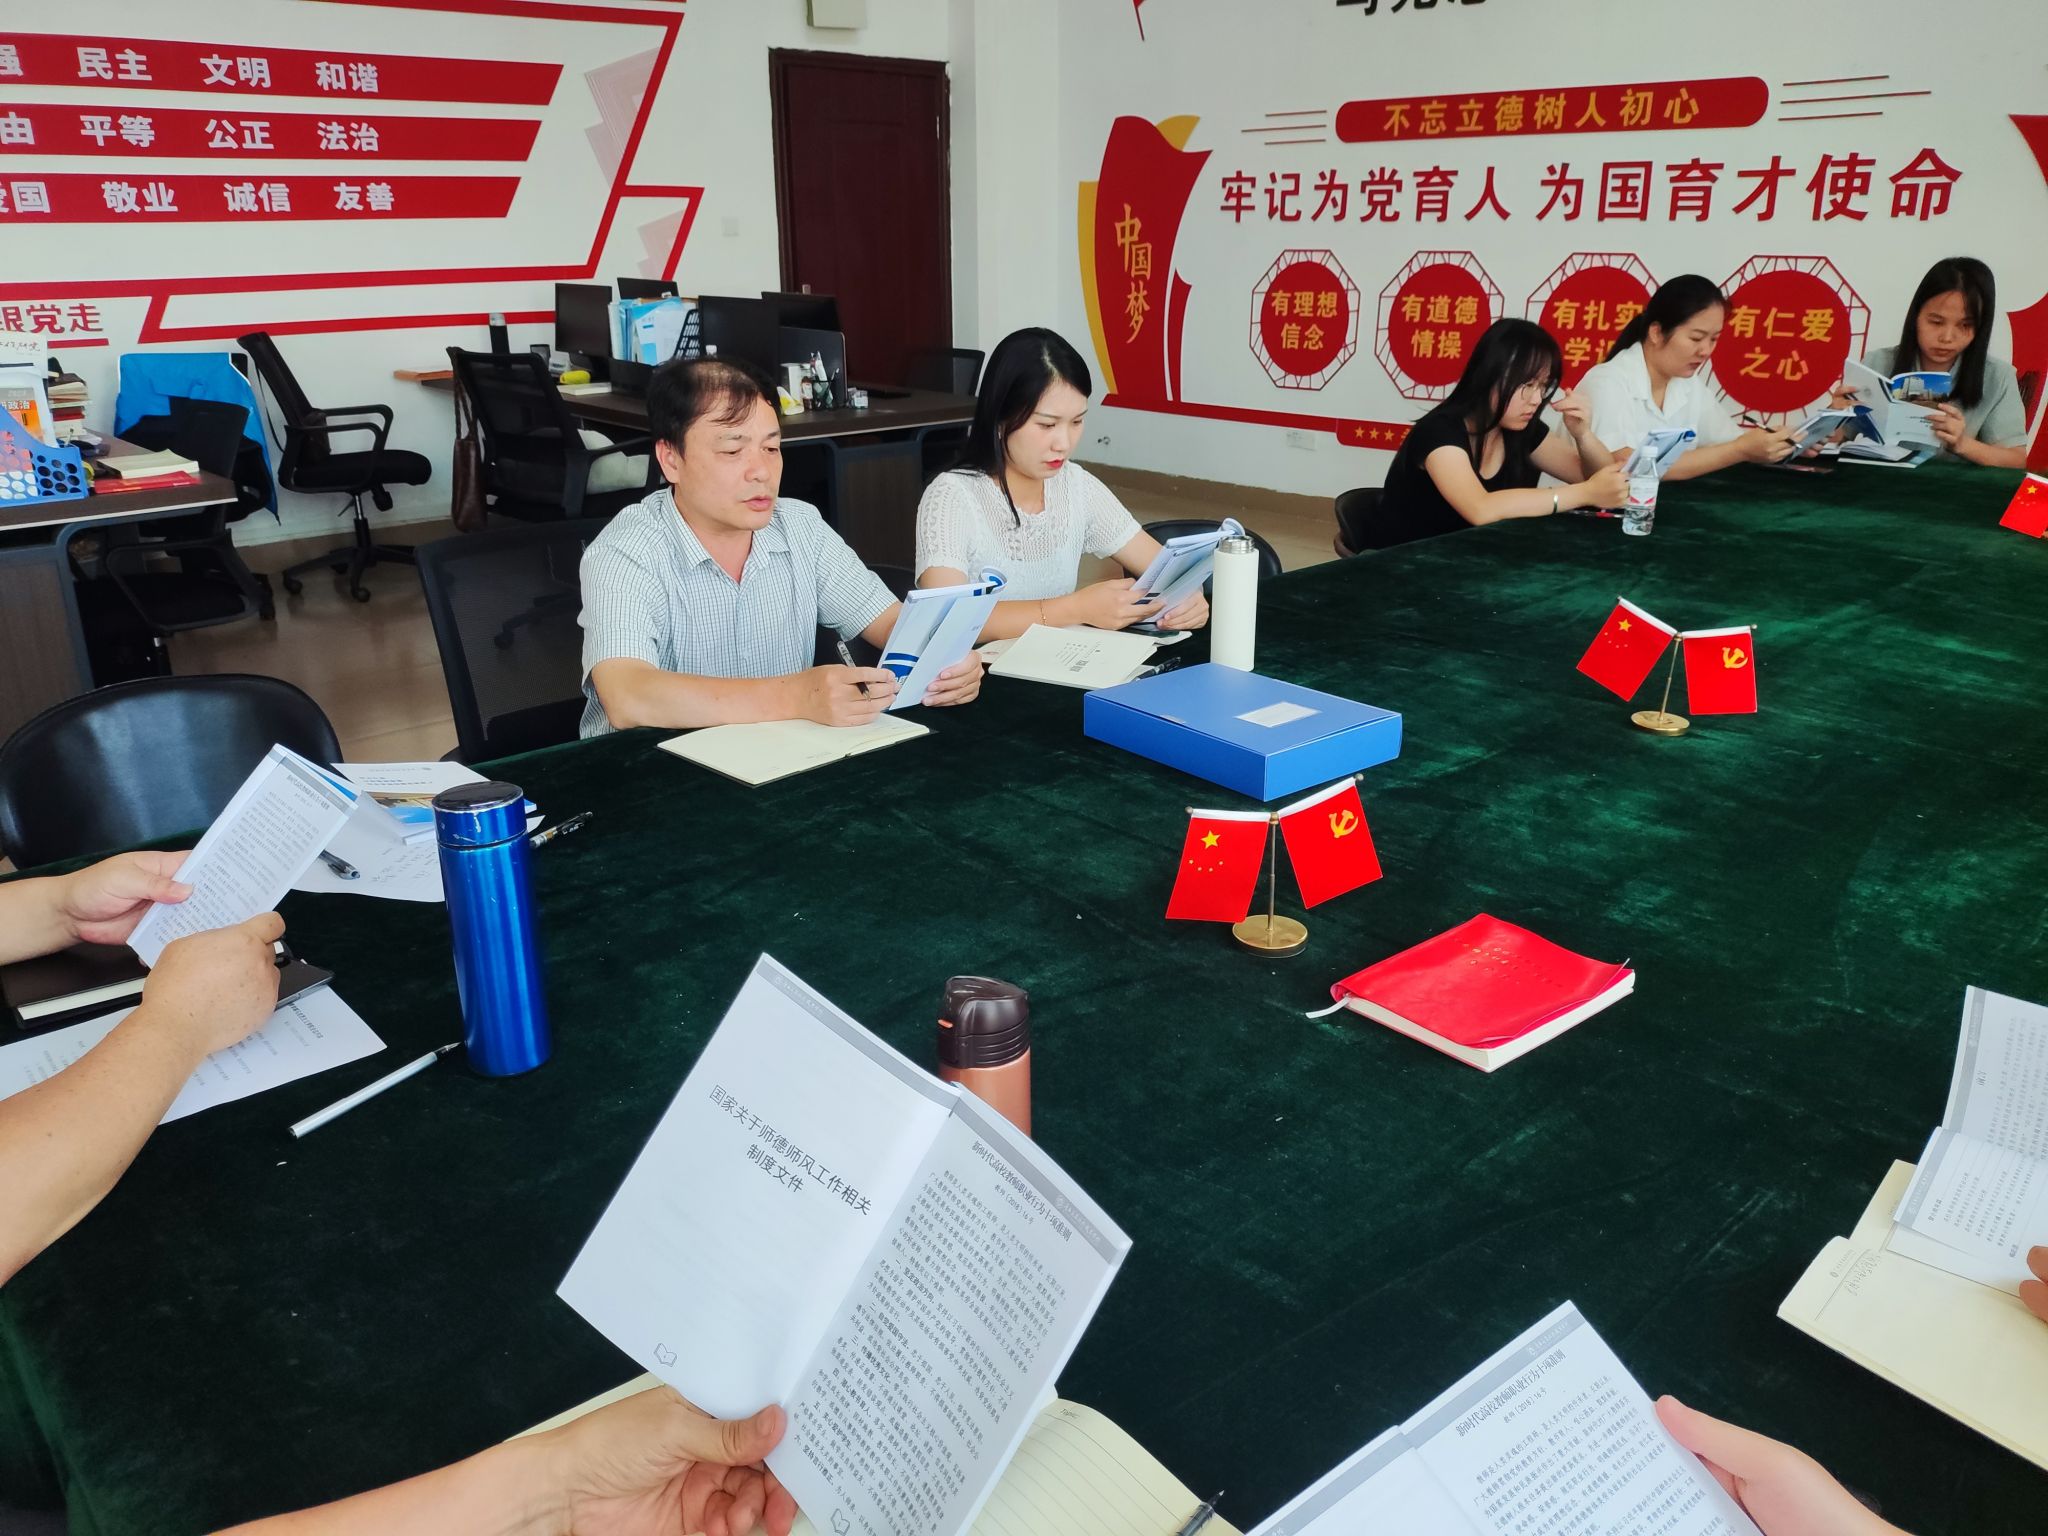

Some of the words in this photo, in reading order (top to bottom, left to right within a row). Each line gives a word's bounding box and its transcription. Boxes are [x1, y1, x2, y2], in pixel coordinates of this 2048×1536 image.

[76, 47, 152, 81] 民主
[200, 54, 271, 88] 文明
[315, 61, 379, 93] 和谐
[1384, 87, 1700, 137] 不忘立德树人初心
[0, 112, 35, 145] 由
[80, 114, 155, 148] 平等
[205, 119, 274, 150] 公正
[317, 122, 379, 152] 法治
[0, 181, 51, 213] 国
[101, 181, 178, 213] 敬业
[223, 182, 291, 212] 诚信
[333, 182, 394, 211] 友善
[1220, 165, 1511, 224] 牢记为党育人
[1536, 146, 1964, 224] 为国育才使命
[1114, 202, 1152, 344] 中国梦
[1271, 290, 1338, 319] 有理想
[1401, 294, 1479, 325] 有道德
[1553, 298, 1643, 331] 有扎实
[1281, 323, 1325, 351] 信念
[1729, 305, 1834, 343] 有仁爱
[1411, 329, 1462, 360] 情操
[1739, 347, 1808, 381] 之心
[709, 1084, 872, 1216] 国家关于师德师风工作相关
[746, 1143, 804, 1193] 制度文件
